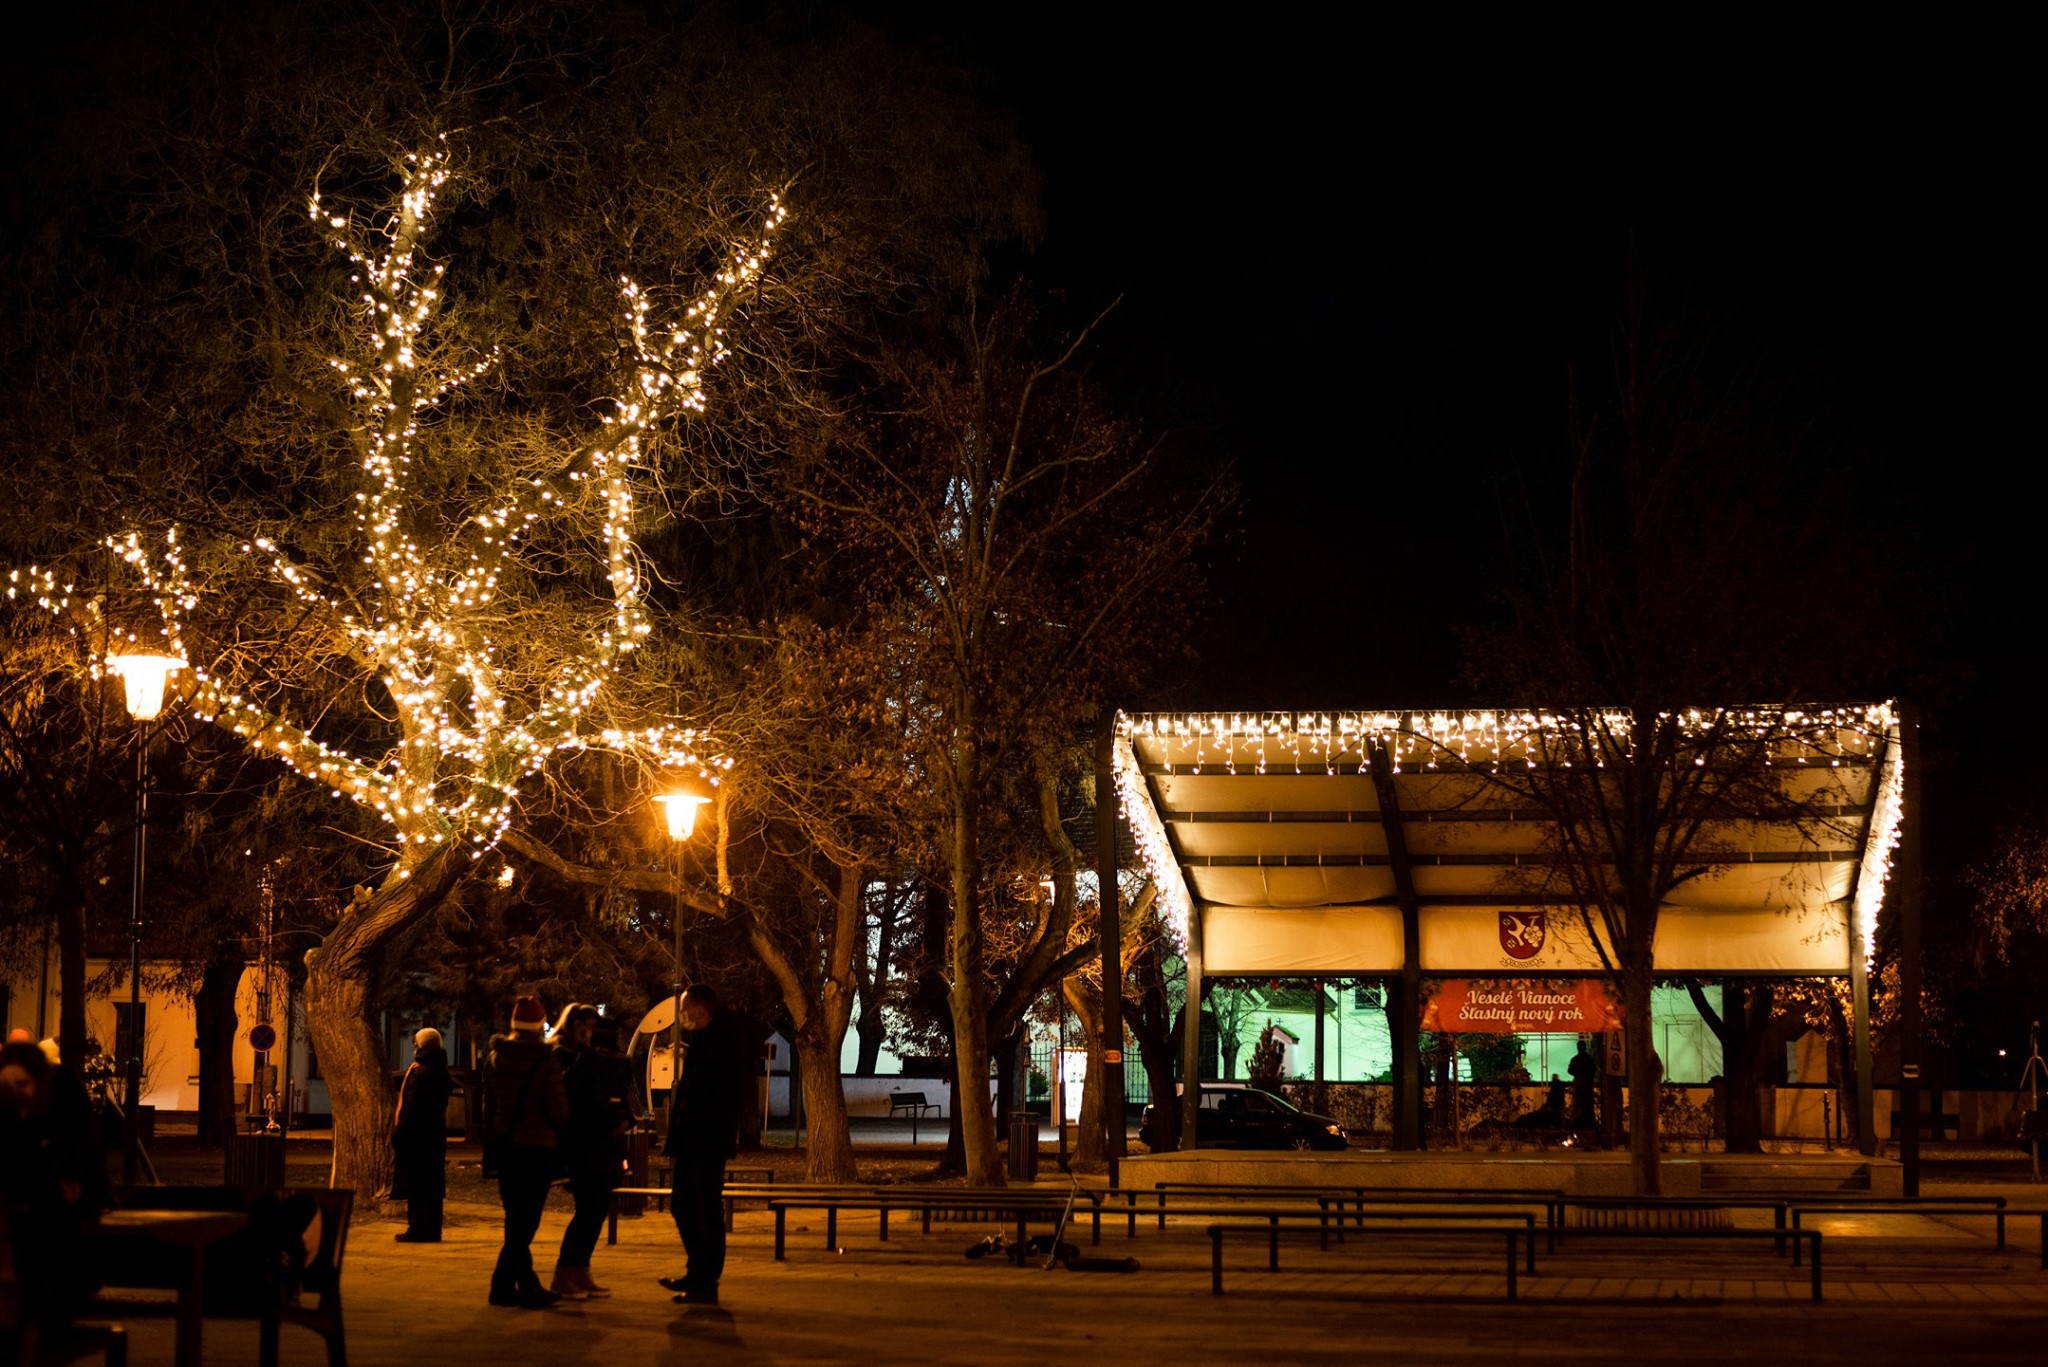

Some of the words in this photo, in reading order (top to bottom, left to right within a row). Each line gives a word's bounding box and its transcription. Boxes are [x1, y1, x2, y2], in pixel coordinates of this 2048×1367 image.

[1467, 990, 1513, 1005] Veselé
[1517, 990, 1576, 1005] Vianoce
[1459, 1002, 1516, 1024] Šťastný
[1519, 1006, 1555, 1024] nový
[1558, 1007, 1584, 1020] rok
